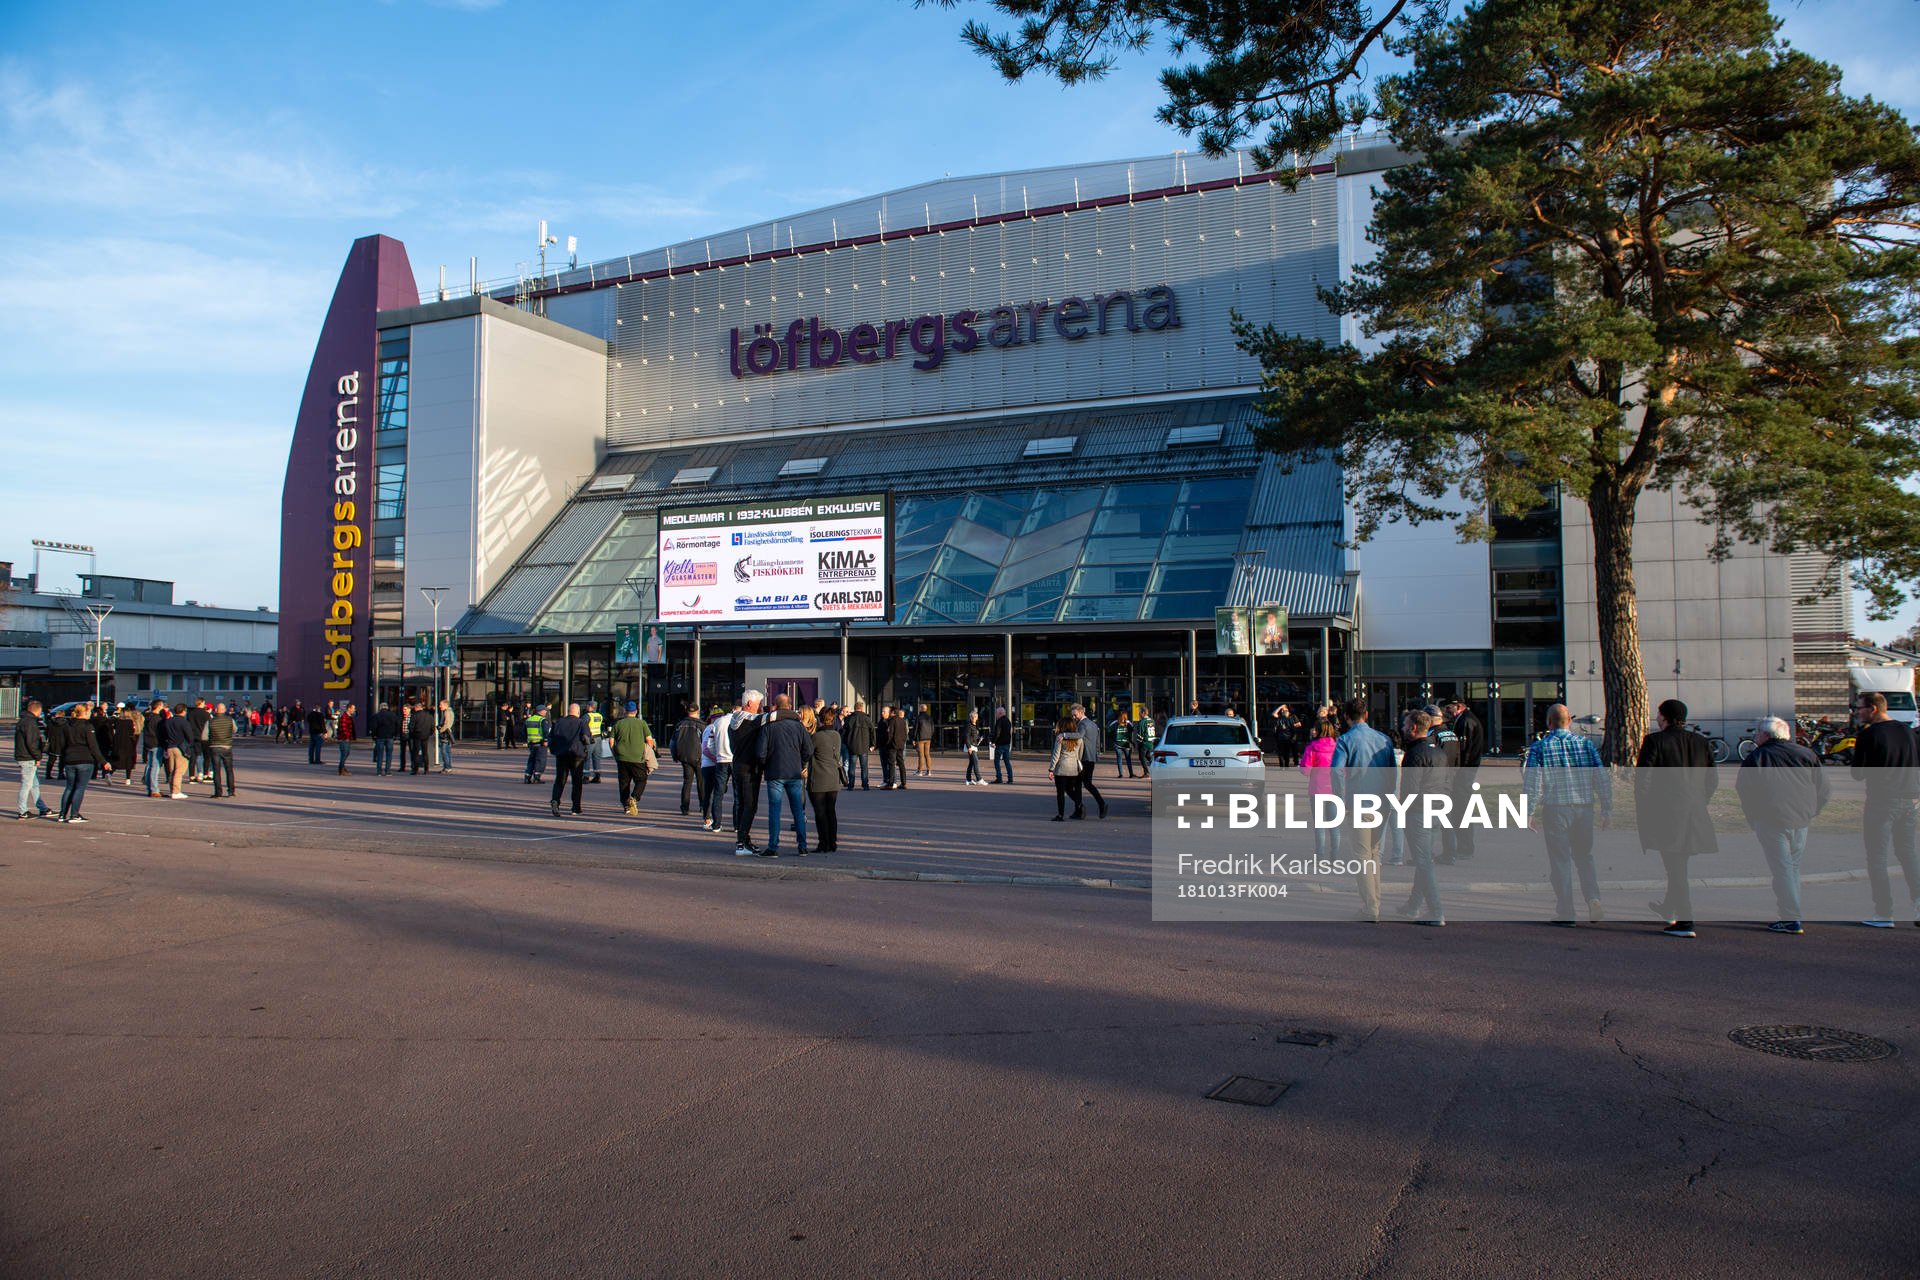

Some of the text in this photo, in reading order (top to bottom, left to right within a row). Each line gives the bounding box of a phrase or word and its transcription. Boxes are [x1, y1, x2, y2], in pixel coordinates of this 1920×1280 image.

[729, 283, 1181, 378] löfbergsarena
[663, 512, 725, 525] MEDLEMMAR
[736, 506, 813, 520] 1932-KLUBBEN
[817, 501, 881, 515] EXKLUSIVE
[323, 371, 362, 689] löfbergsarena
[873, 527, 882, 535] AB
[676, 540, 721, 549] Rörmontage
[663, 559, 695, 583] Kjells
[753, 566, 804, 577] FISKRÖKERI
[818, 569, 876, 578] ENTREPRENAD
[791, 594, 808, 602] AB
[822, 591, 883, 604] KARLSTAD
[848, 602, 883, 610] MEKANISKA
